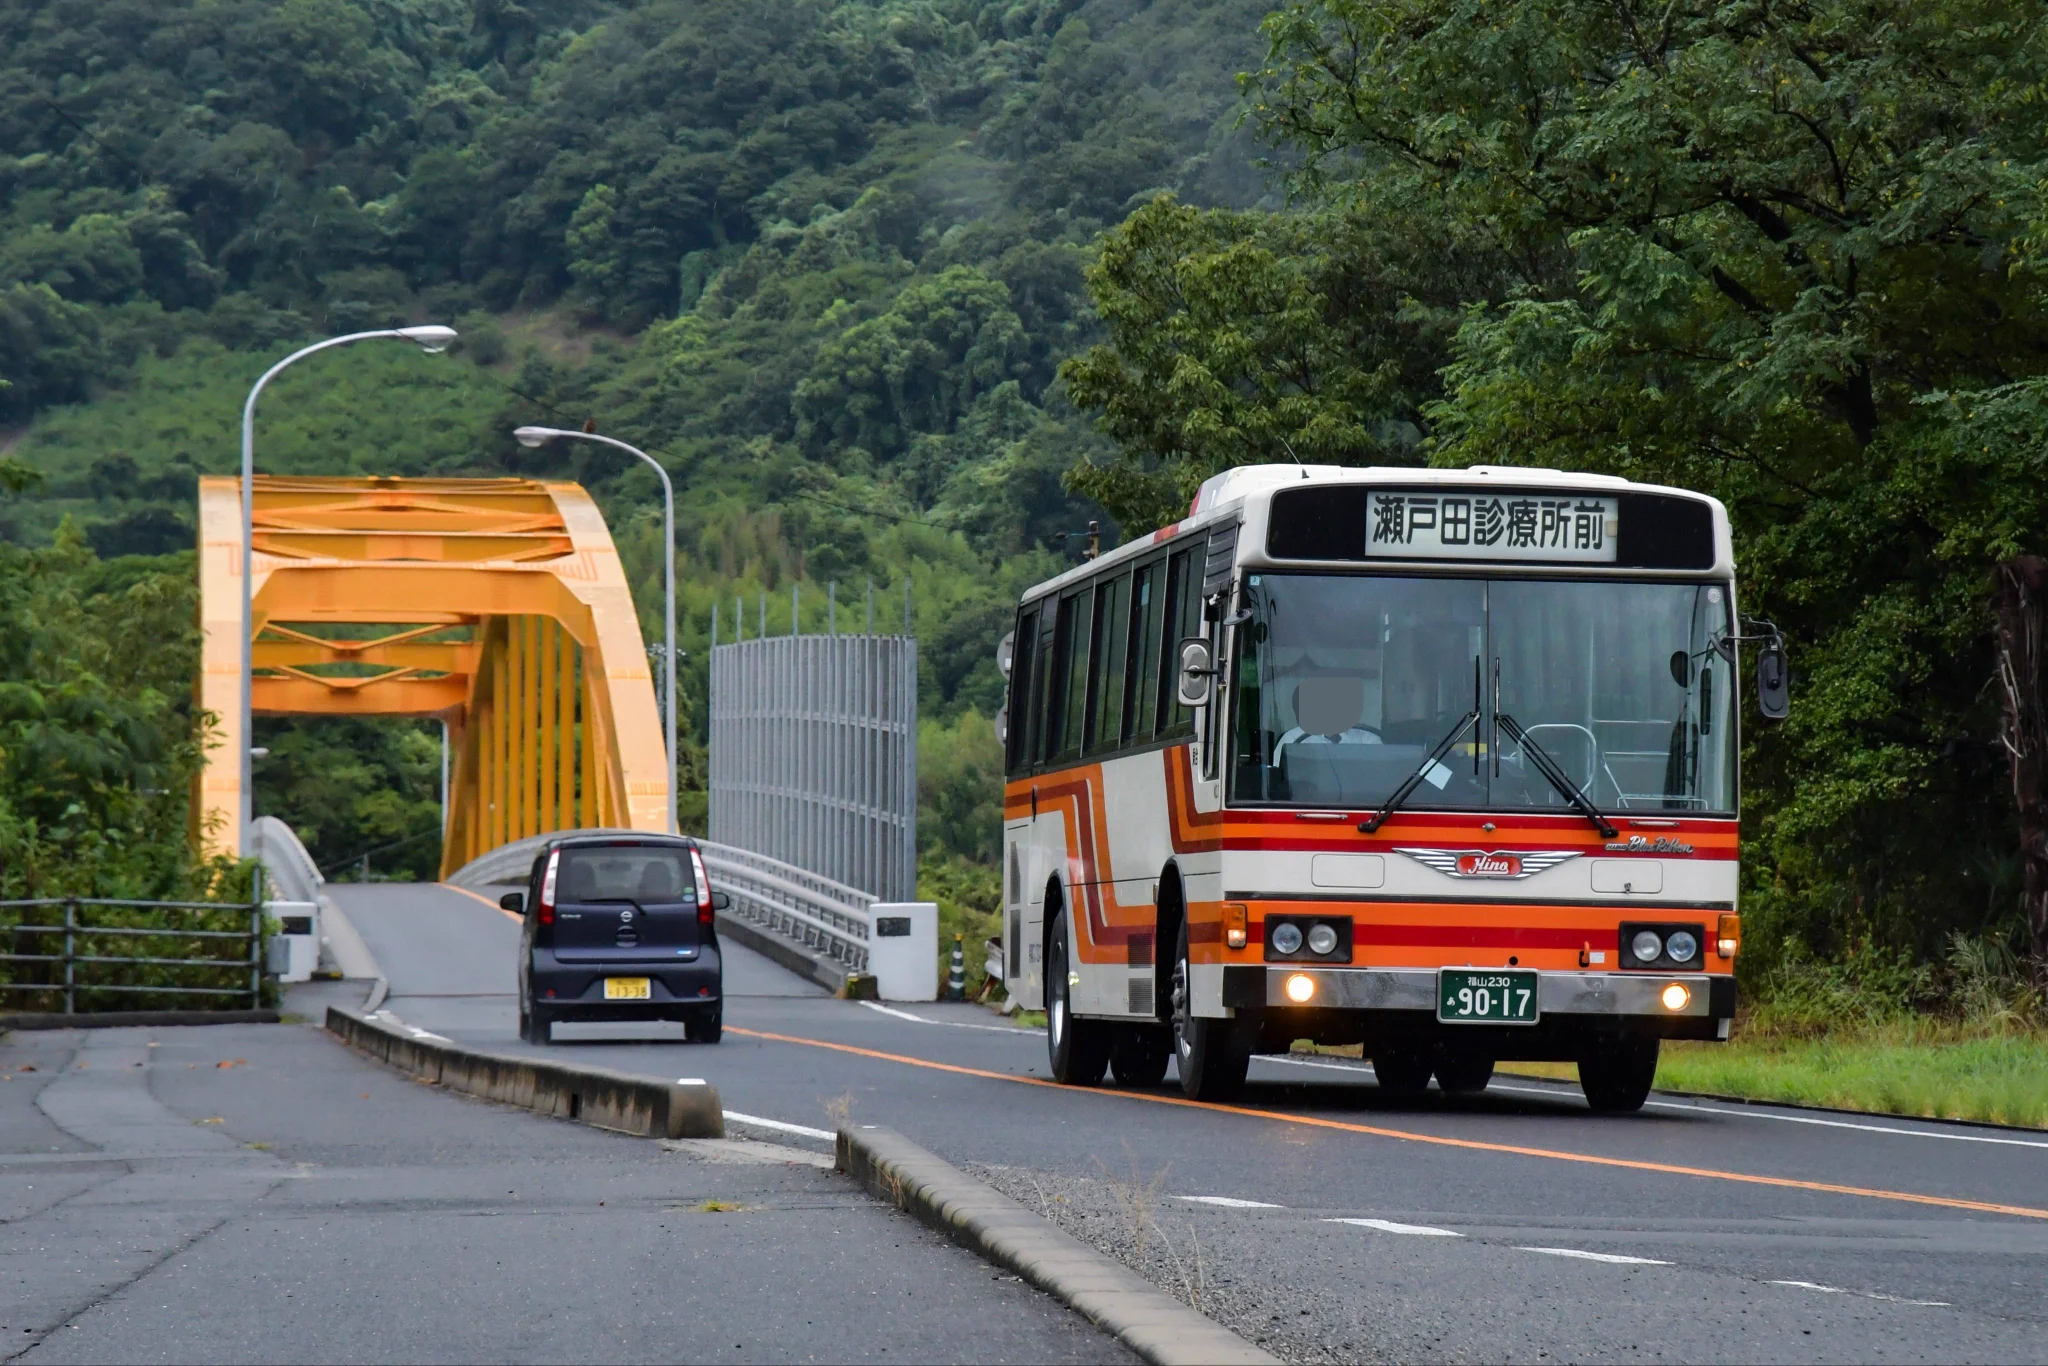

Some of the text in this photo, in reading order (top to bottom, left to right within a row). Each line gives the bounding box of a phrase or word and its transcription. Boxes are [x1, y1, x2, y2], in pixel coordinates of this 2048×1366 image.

[1373, 495, 1605, 550] 瀬戸田診療所前
[1628, 835, 1654, 852] Blue
[1655, 837, 1694, 853] Ribbon
[1468, 856, 1509, 875] Hino
[1458, 988, 1531, 1017] 90-17
